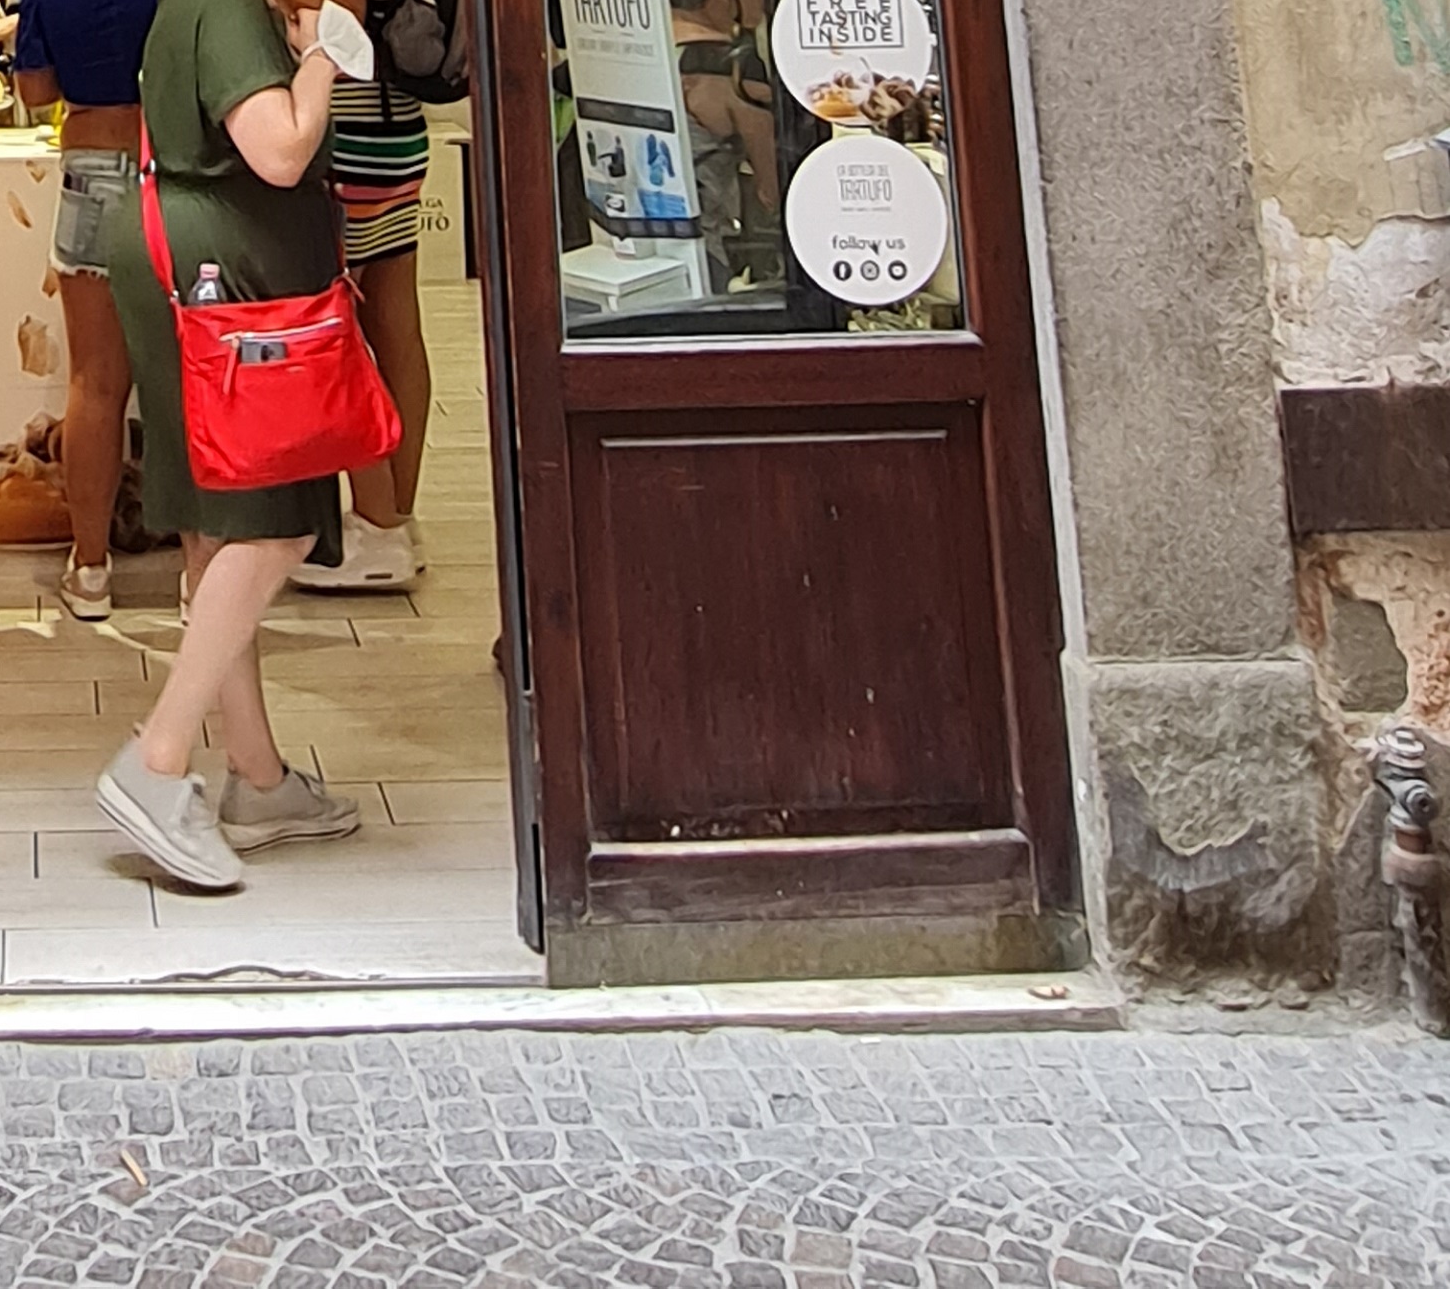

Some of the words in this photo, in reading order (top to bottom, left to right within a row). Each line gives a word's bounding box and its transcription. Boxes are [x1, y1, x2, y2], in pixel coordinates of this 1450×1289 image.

[809, 9, 893, 27] TASTING
[809, 25, 893, 44] INSIDE
[839, 178, 893, 202] TARTUFO
[832, 234, 882, 251] follow
[886, 237, 906, 251] us
